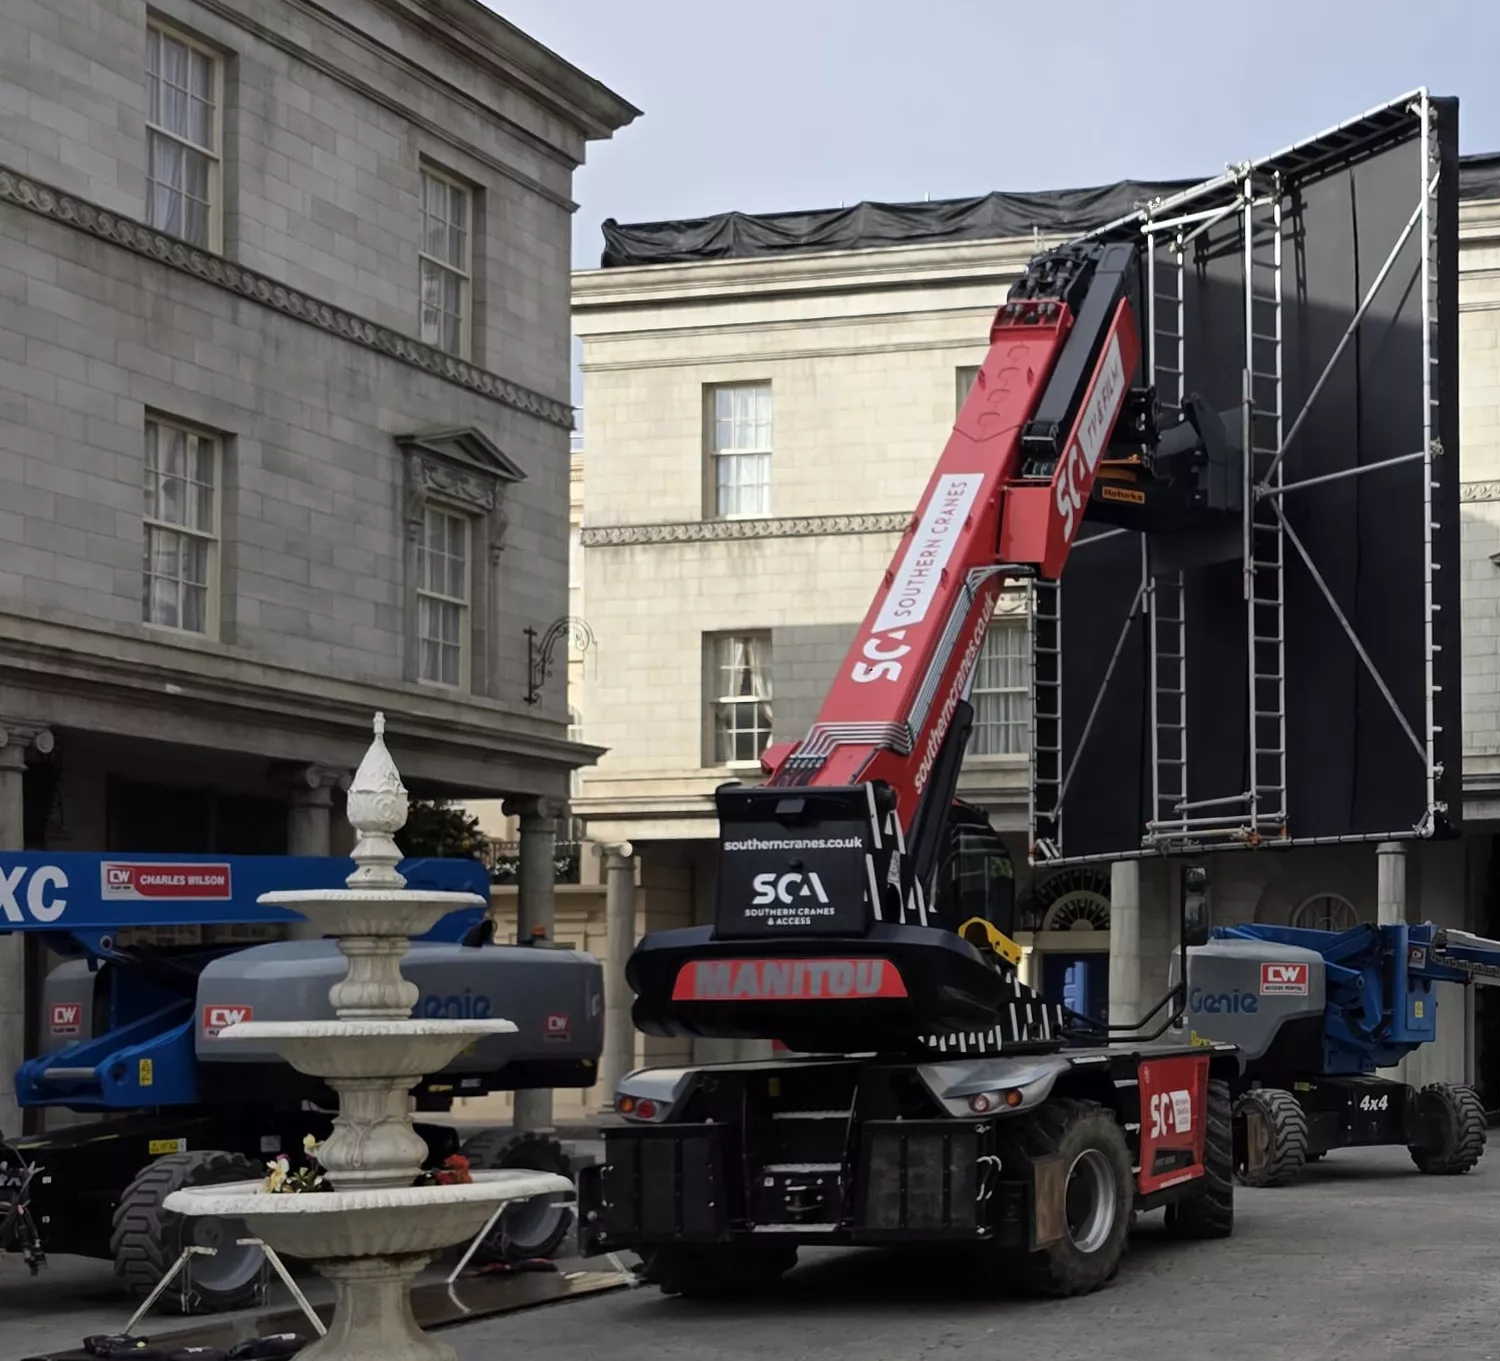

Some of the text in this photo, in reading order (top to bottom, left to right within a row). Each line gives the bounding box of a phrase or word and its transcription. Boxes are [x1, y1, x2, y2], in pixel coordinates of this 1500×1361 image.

[894, 481, 968, 617] SOUTHERN CRANES
[914, 591, 995, 796] southerncranes.co.uk
[724, 836, 863, 851] southerncranes.co.uk
[109, 871, 130, 883] CW
[140, 875, 225, 886] CHARLES WILSON
[752, 872, 829, 904] SCA
[745, 907, 835, 917] SOUTHERN CRANES
[767, 916, 811, 926] & ACCESS
[695, 960, 884, 997] MANITOU
[1268, 966, 1300, 982] CW
[413, 986, 492, 1019] enie
[1189, 988, 1259, 1013] Genie
[54, 1006, 77, 1024] CW
[210, 1008, 246, 1026] CW
[1359, 1094, 1389, 1111] 4x4
